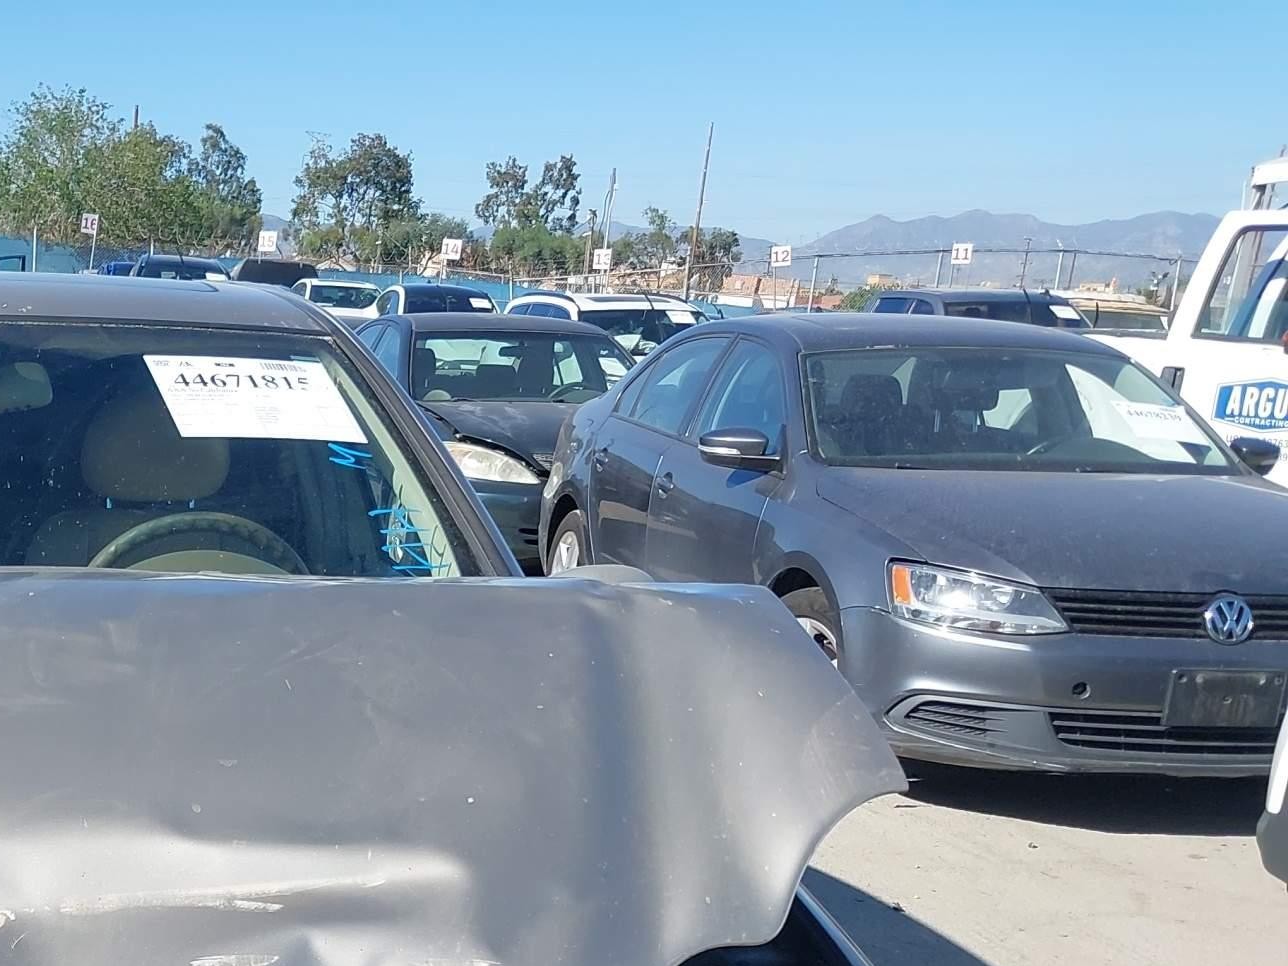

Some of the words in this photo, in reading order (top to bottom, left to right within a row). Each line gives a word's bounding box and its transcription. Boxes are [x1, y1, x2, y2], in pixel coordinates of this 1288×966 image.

[82, 217, 97, 231] 16
[259, 235, 275, 248] 15
[443, 242, 459, 255] 14
[952, 248, 969, 260] 11
[772, 250, 790, 263] 12
[174, 372, 309, 391] 44671815
[1225, 384, 1288, 419] ARGU
